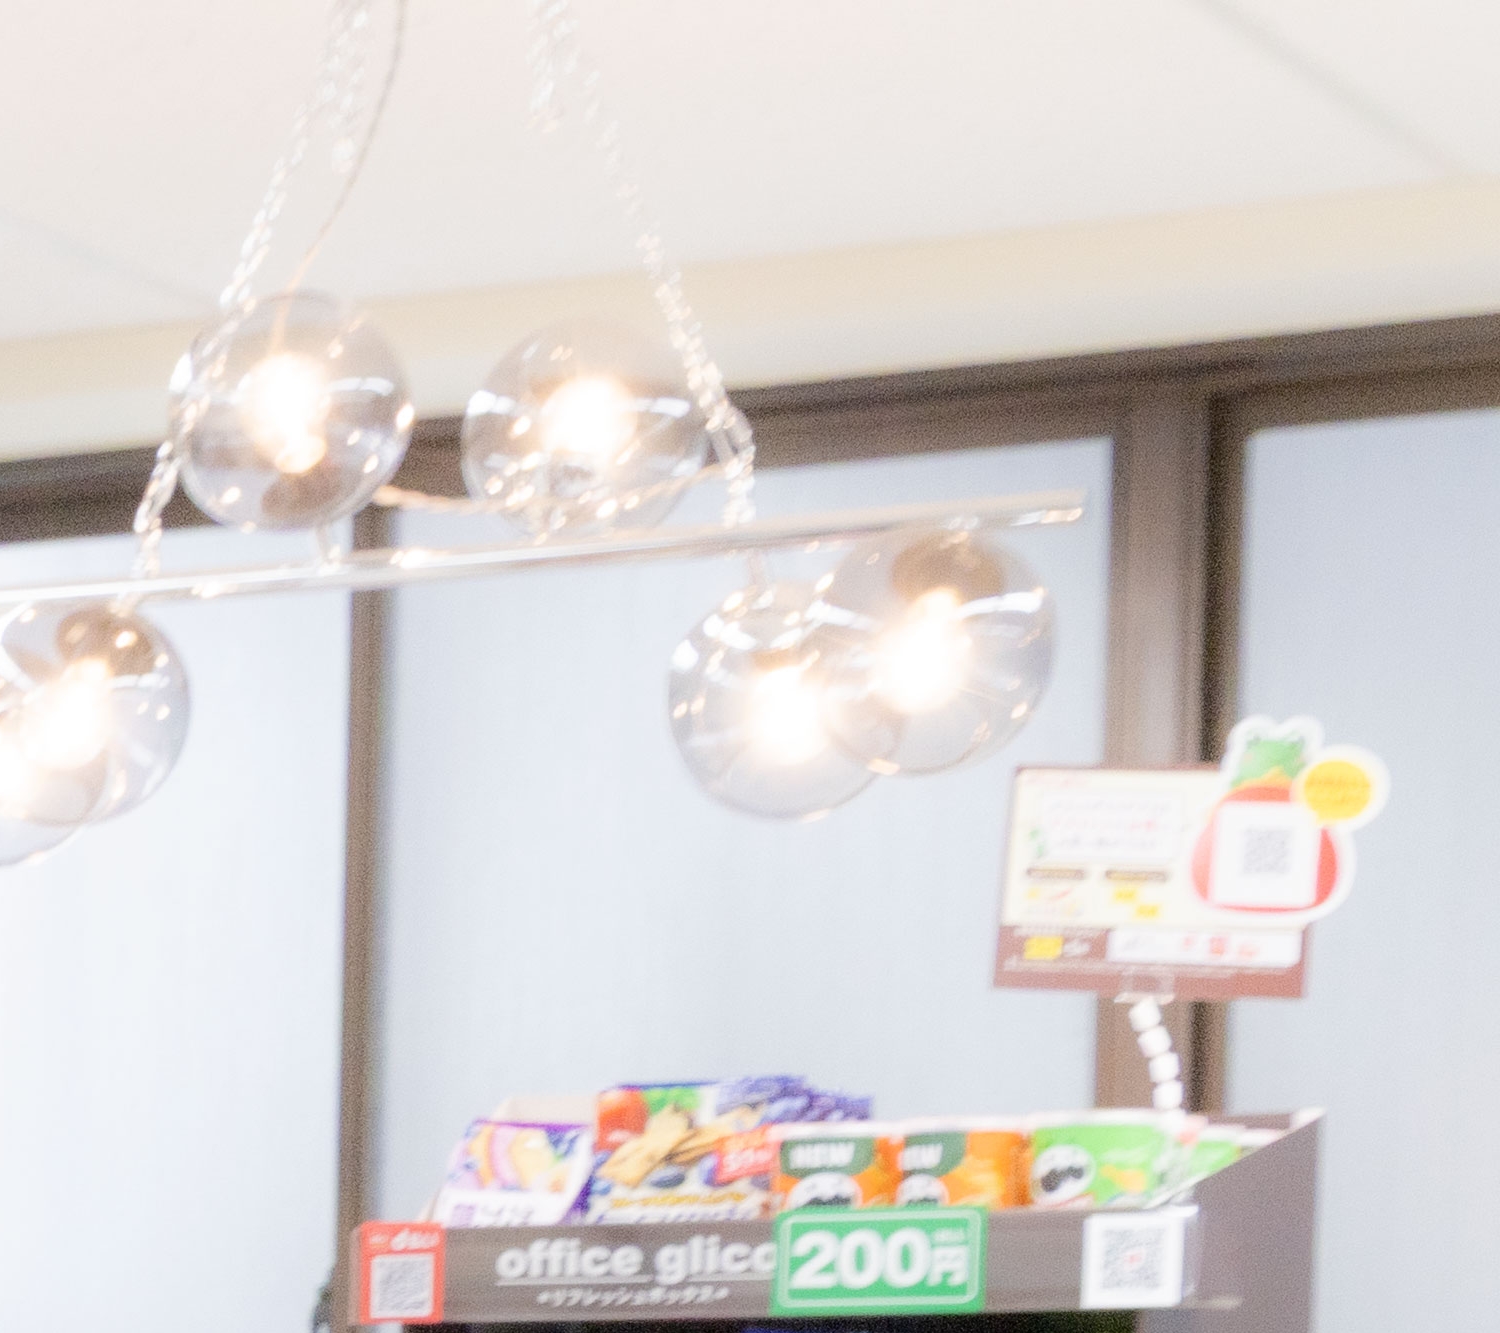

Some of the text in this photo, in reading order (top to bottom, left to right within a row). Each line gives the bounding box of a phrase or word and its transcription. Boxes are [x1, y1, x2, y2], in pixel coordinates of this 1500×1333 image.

[788, 1141, 856, 1169] NEW
[495, 1236, 643, 1278] office
[788, 1226, 970, 1289] 200円
